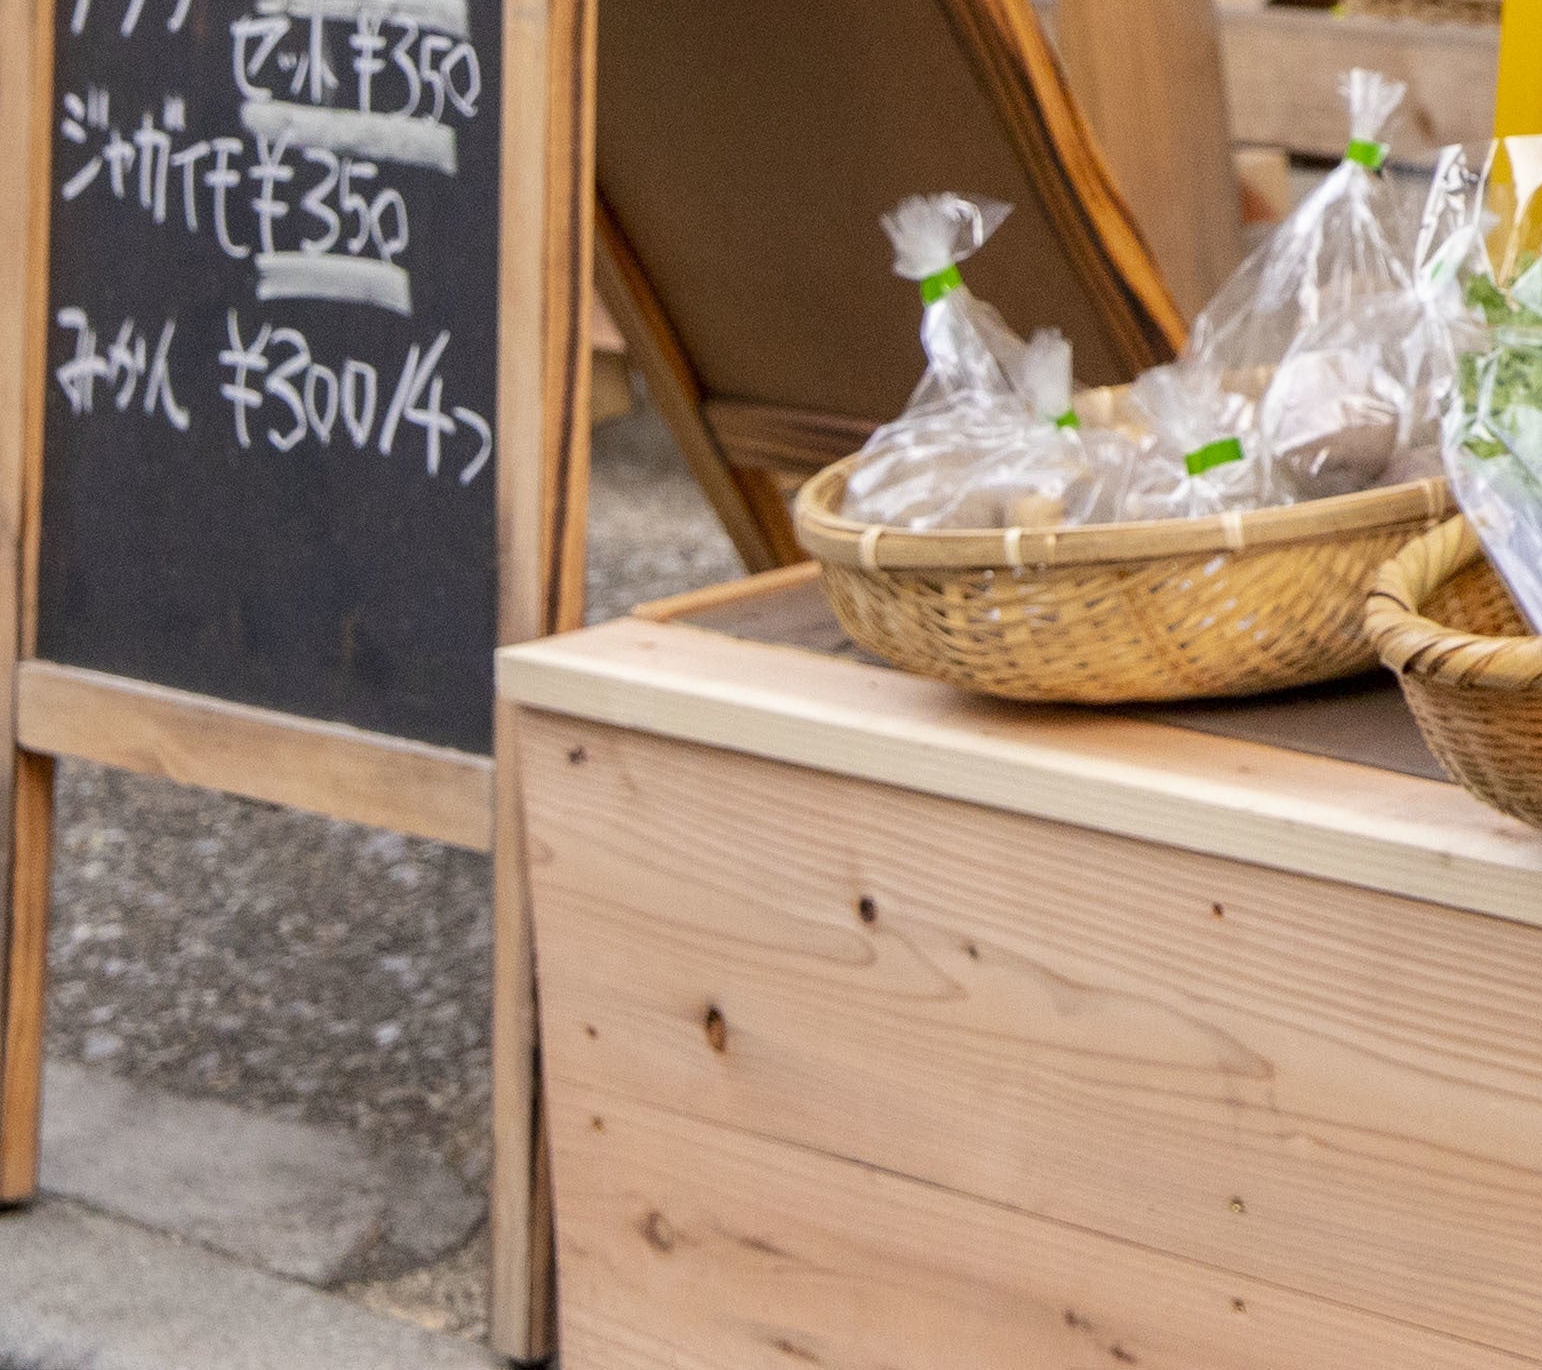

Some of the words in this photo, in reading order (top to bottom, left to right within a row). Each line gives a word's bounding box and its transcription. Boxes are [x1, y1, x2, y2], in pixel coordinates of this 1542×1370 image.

[231, 14, 339, 105] セット
[349, 11, 481, 125] ¥350
[56, 305, 191, 432] みかん
